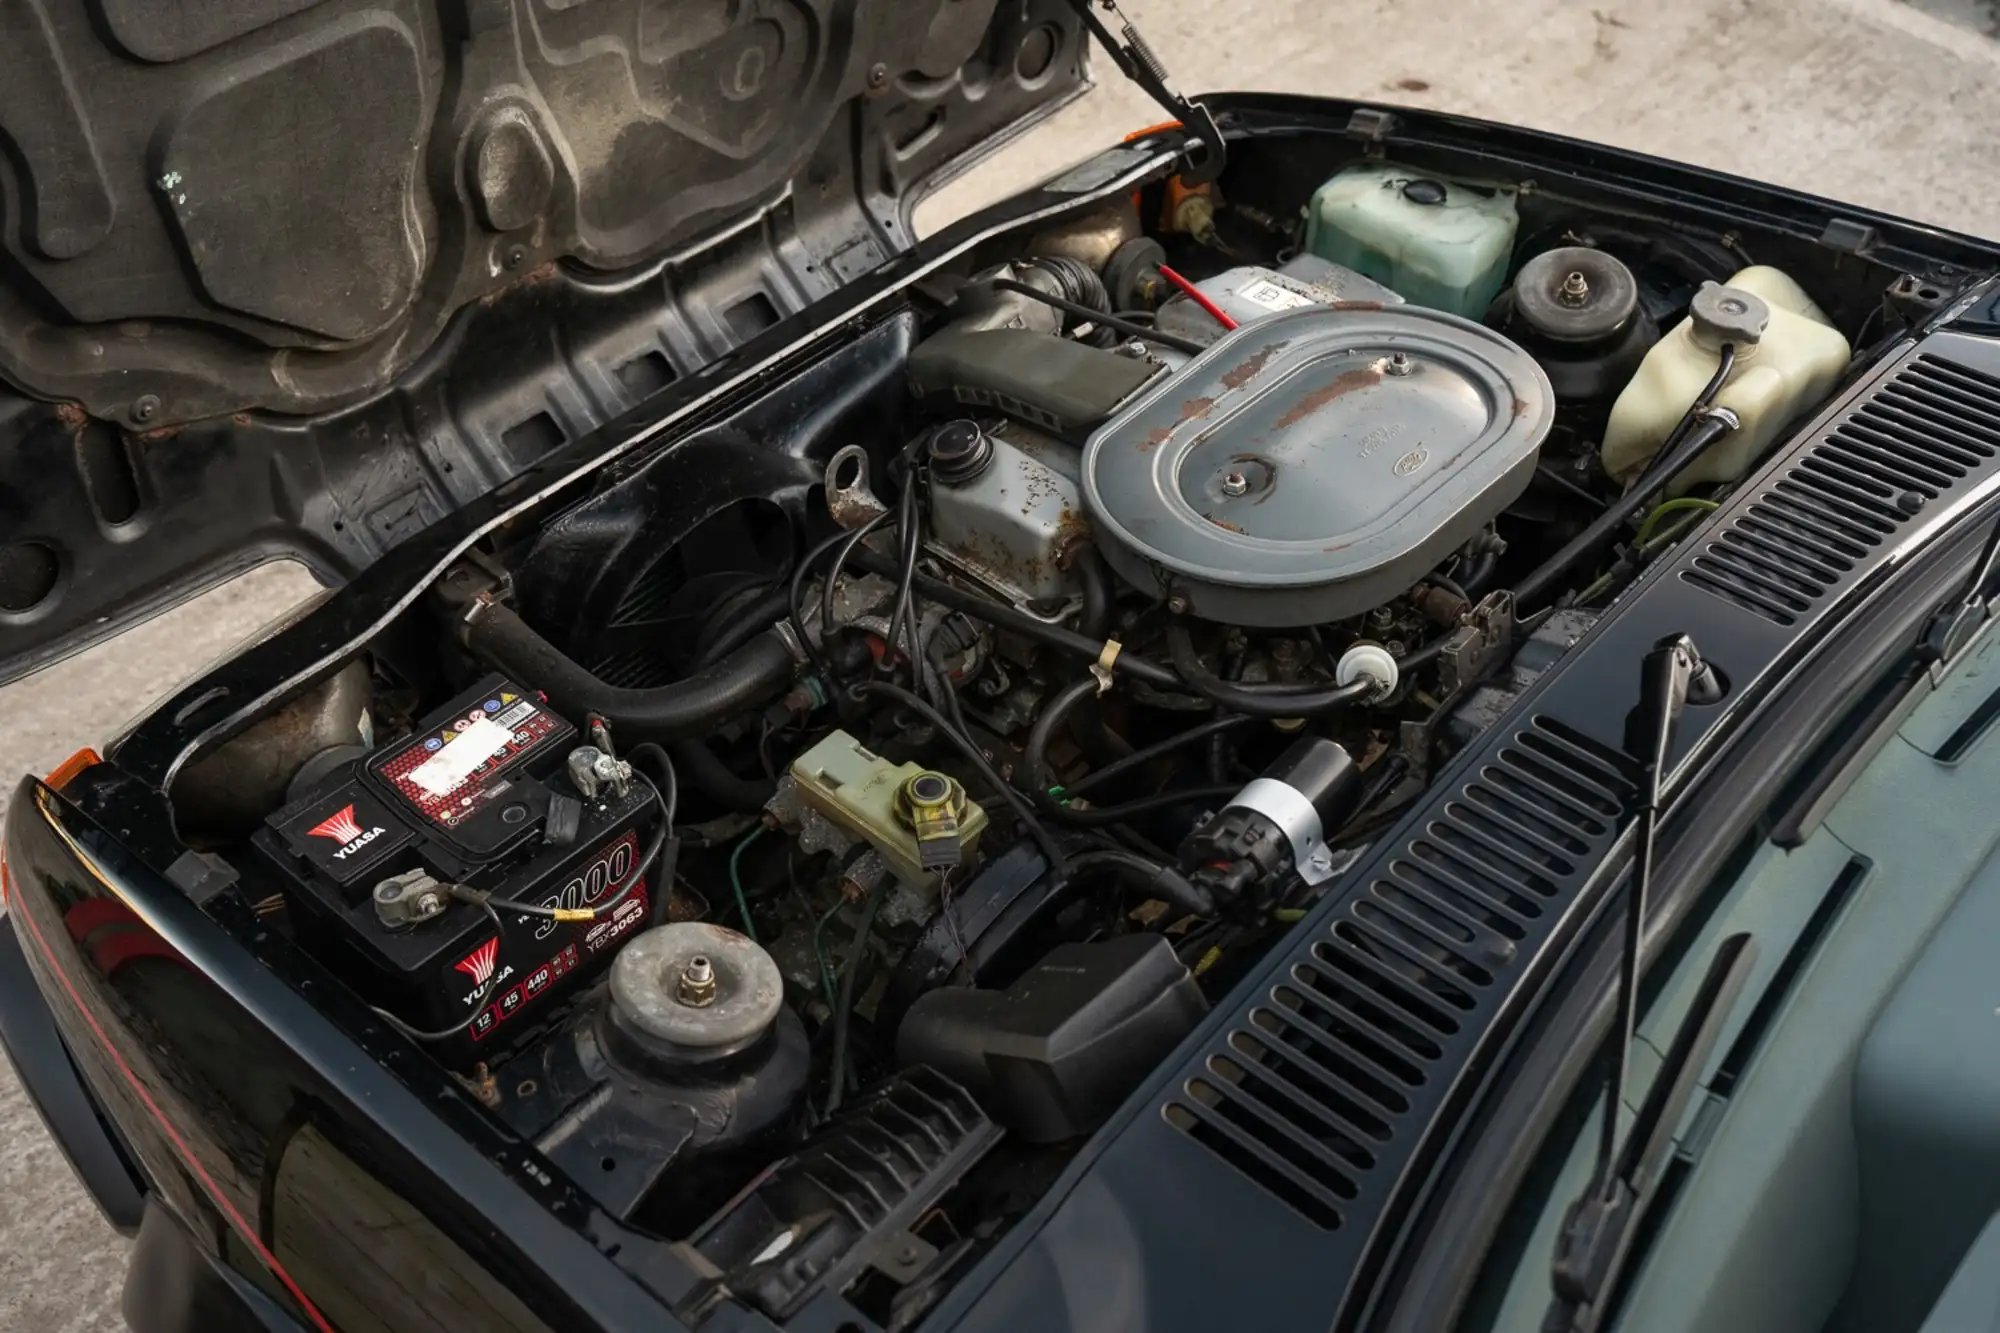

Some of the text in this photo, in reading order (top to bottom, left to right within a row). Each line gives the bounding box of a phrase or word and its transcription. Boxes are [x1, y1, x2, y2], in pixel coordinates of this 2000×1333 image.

[511, 731, 530, 745] 440
[333, 827, 386, 859] YUASA
[535, 842, 632, 940] 3000
[587, 907, 643, 953] YBX3063
[463, 965, 514, 1006] YUSA
[477, 1012, 491, 1028] 12
[504, 991, 518, 1008] 45
[527, 969, 548, 990] 440
